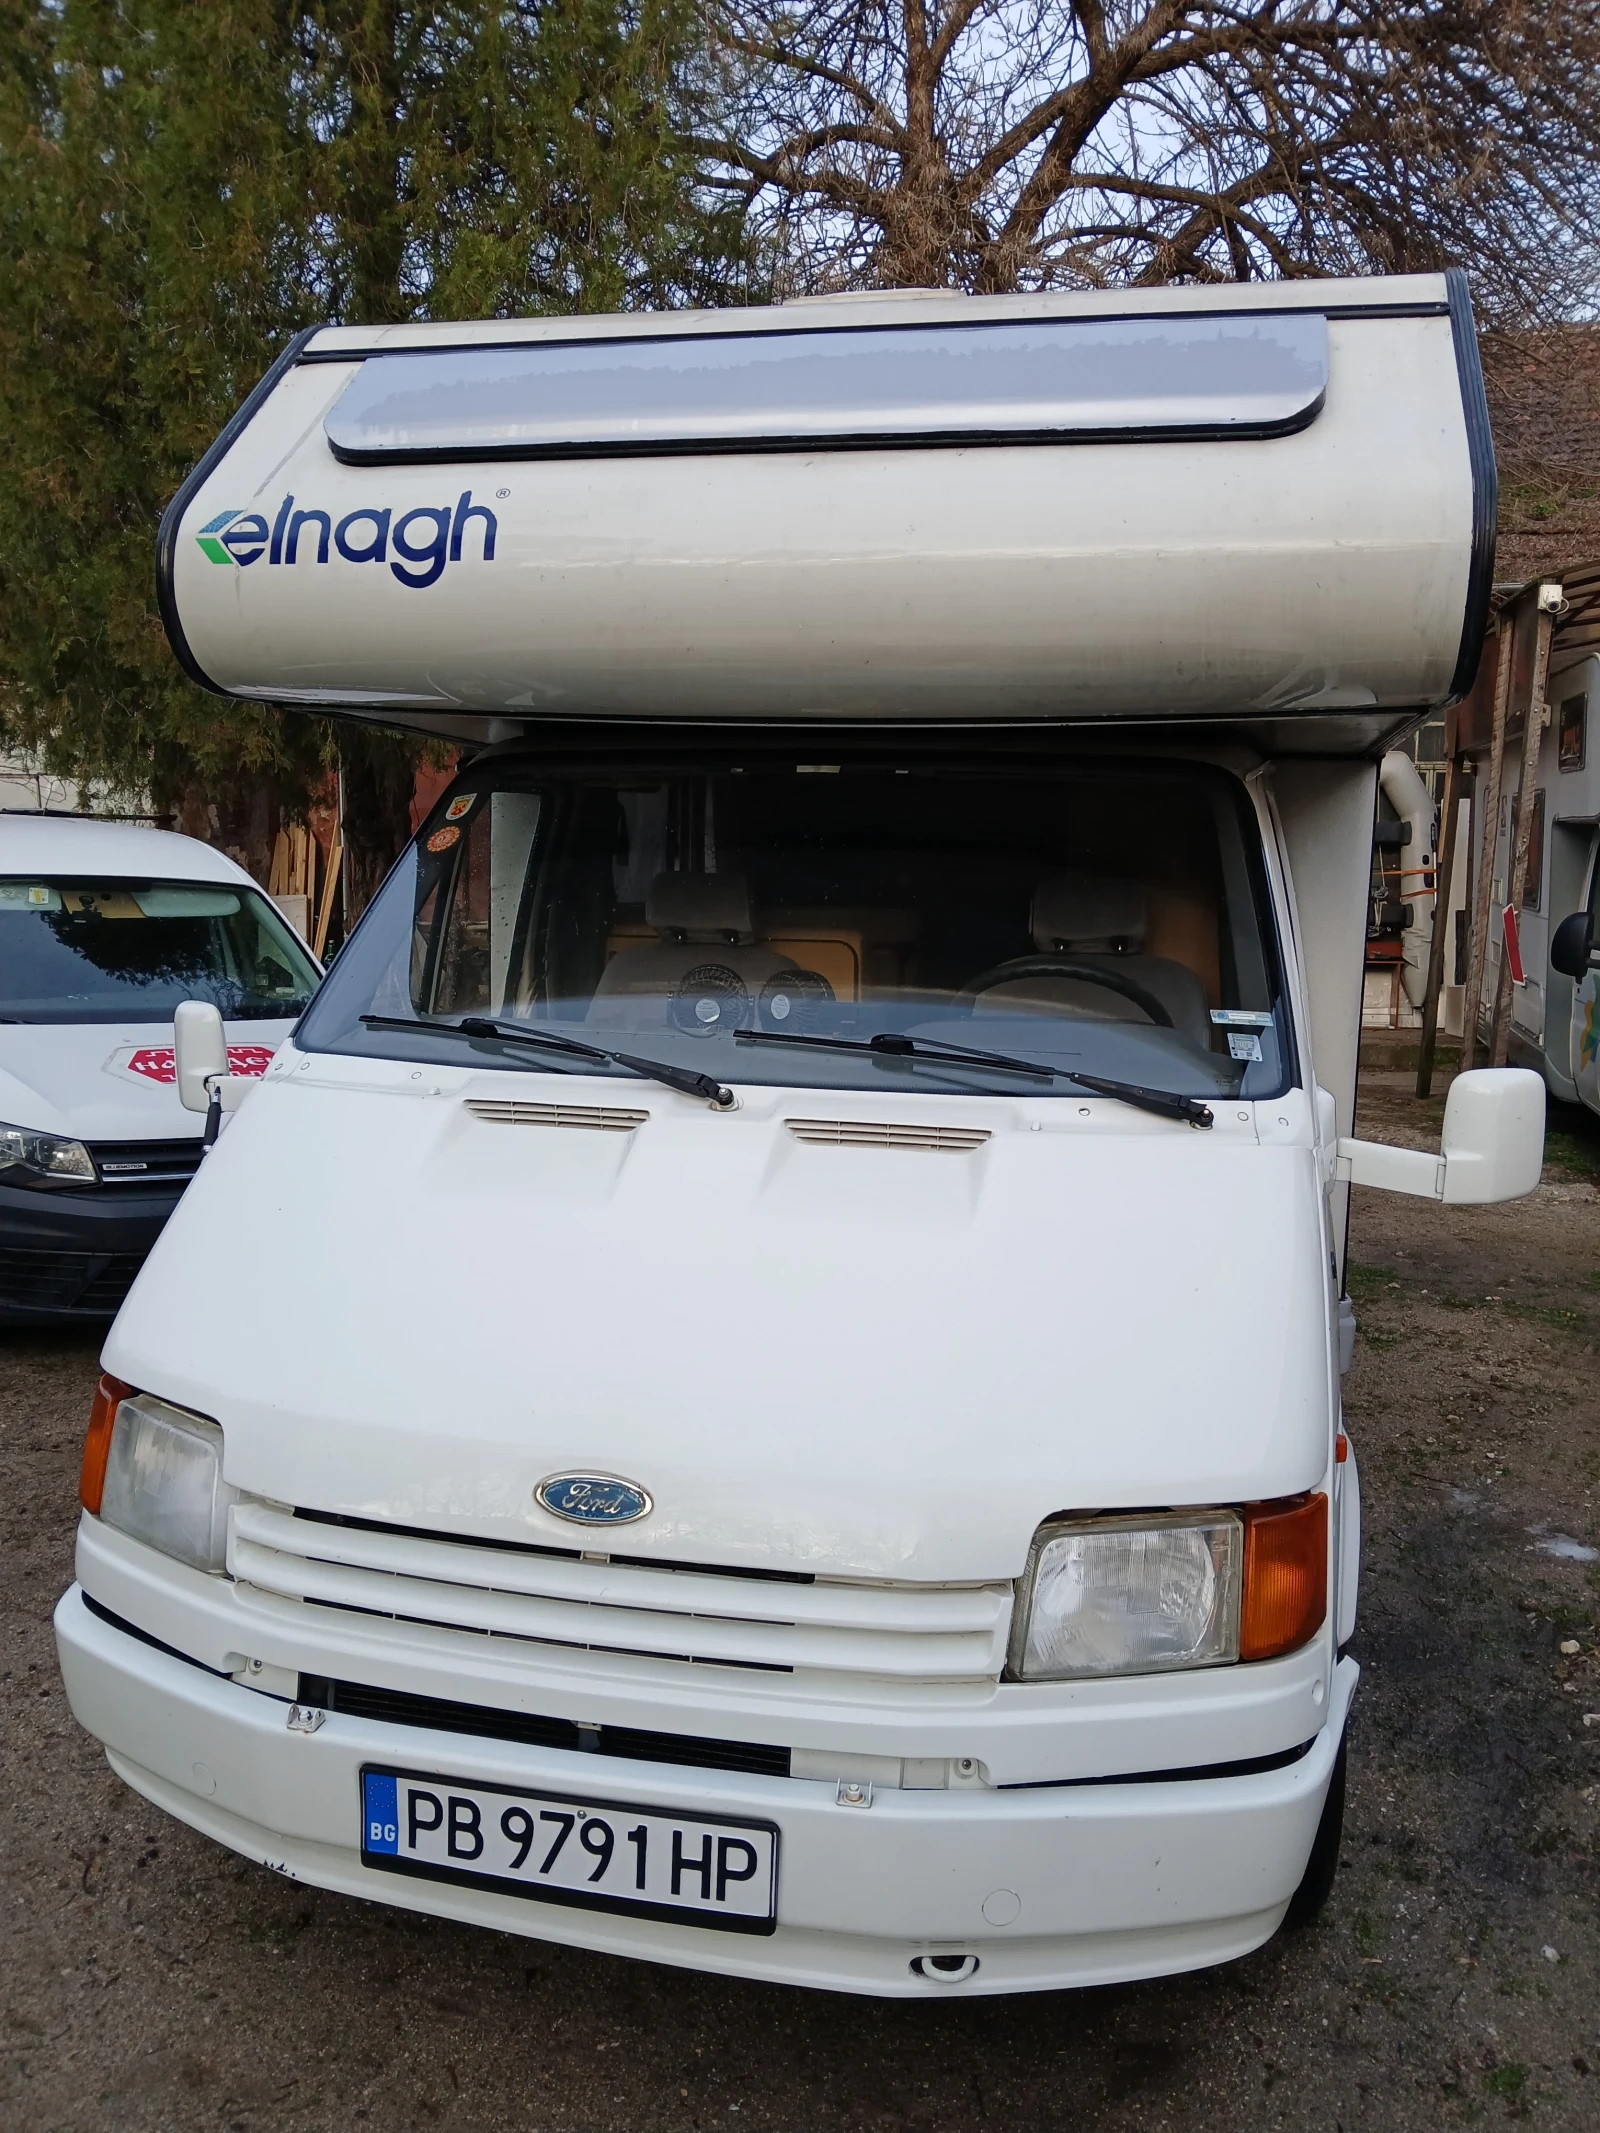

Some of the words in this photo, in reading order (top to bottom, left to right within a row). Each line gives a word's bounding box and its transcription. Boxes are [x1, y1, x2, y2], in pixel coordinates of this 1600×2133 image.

[220, 490, 498, 589] elnagh
[562, 1483, 624, 1514] Ford
[369, 1823, 396, 1843] BG
[407, 1788, 485, 1861] PB
[499, 1805, 647, 1890] 9791
[670, 1829, 758, 1902] HP
